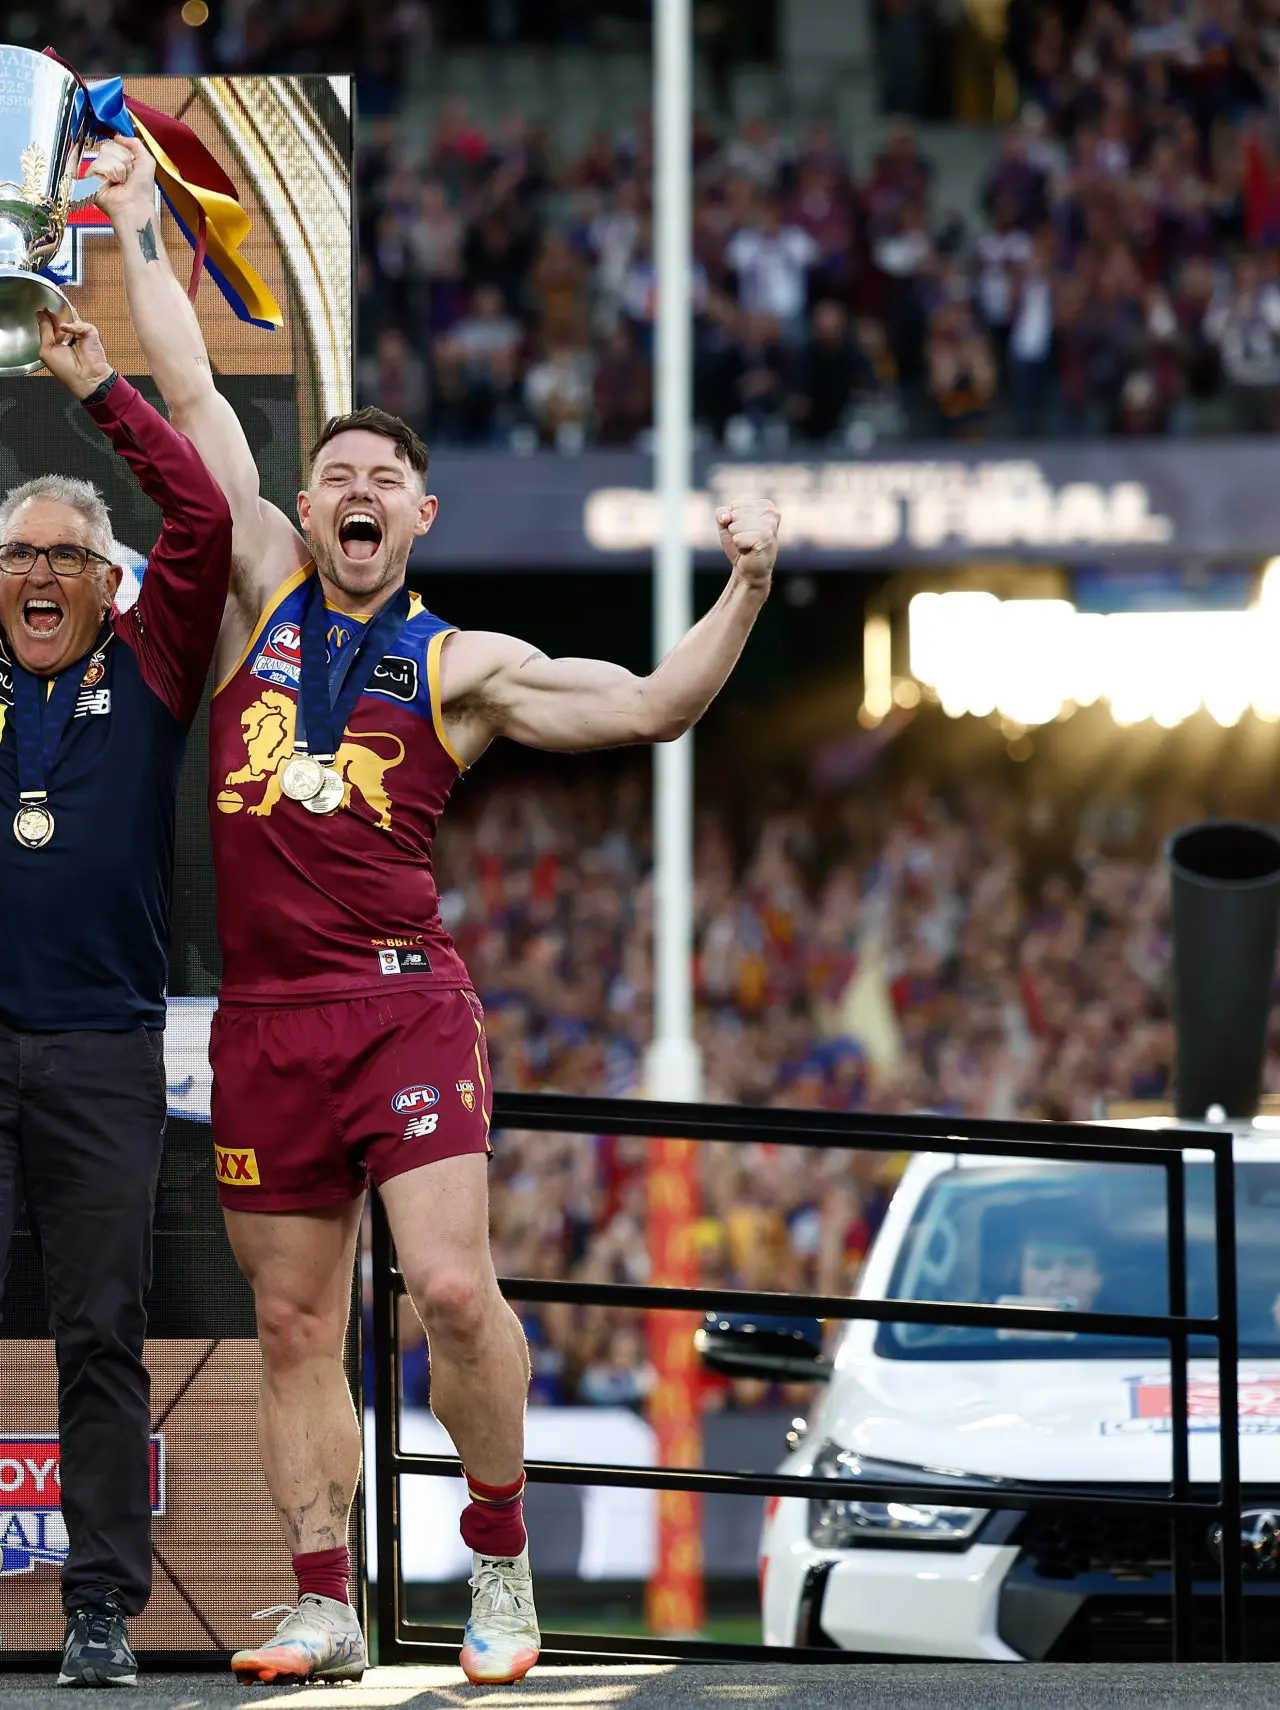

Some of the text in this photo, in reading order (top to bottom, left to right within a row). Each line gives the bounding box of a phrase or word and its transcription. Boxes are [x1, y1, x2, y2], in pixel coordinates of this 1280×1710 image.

[269, 672, 288, 683] 2025
[373, 665, 409, 684] oui
[396, 1090, 436, 1110] AFL
[216, 1151, 254, 1180] XX
